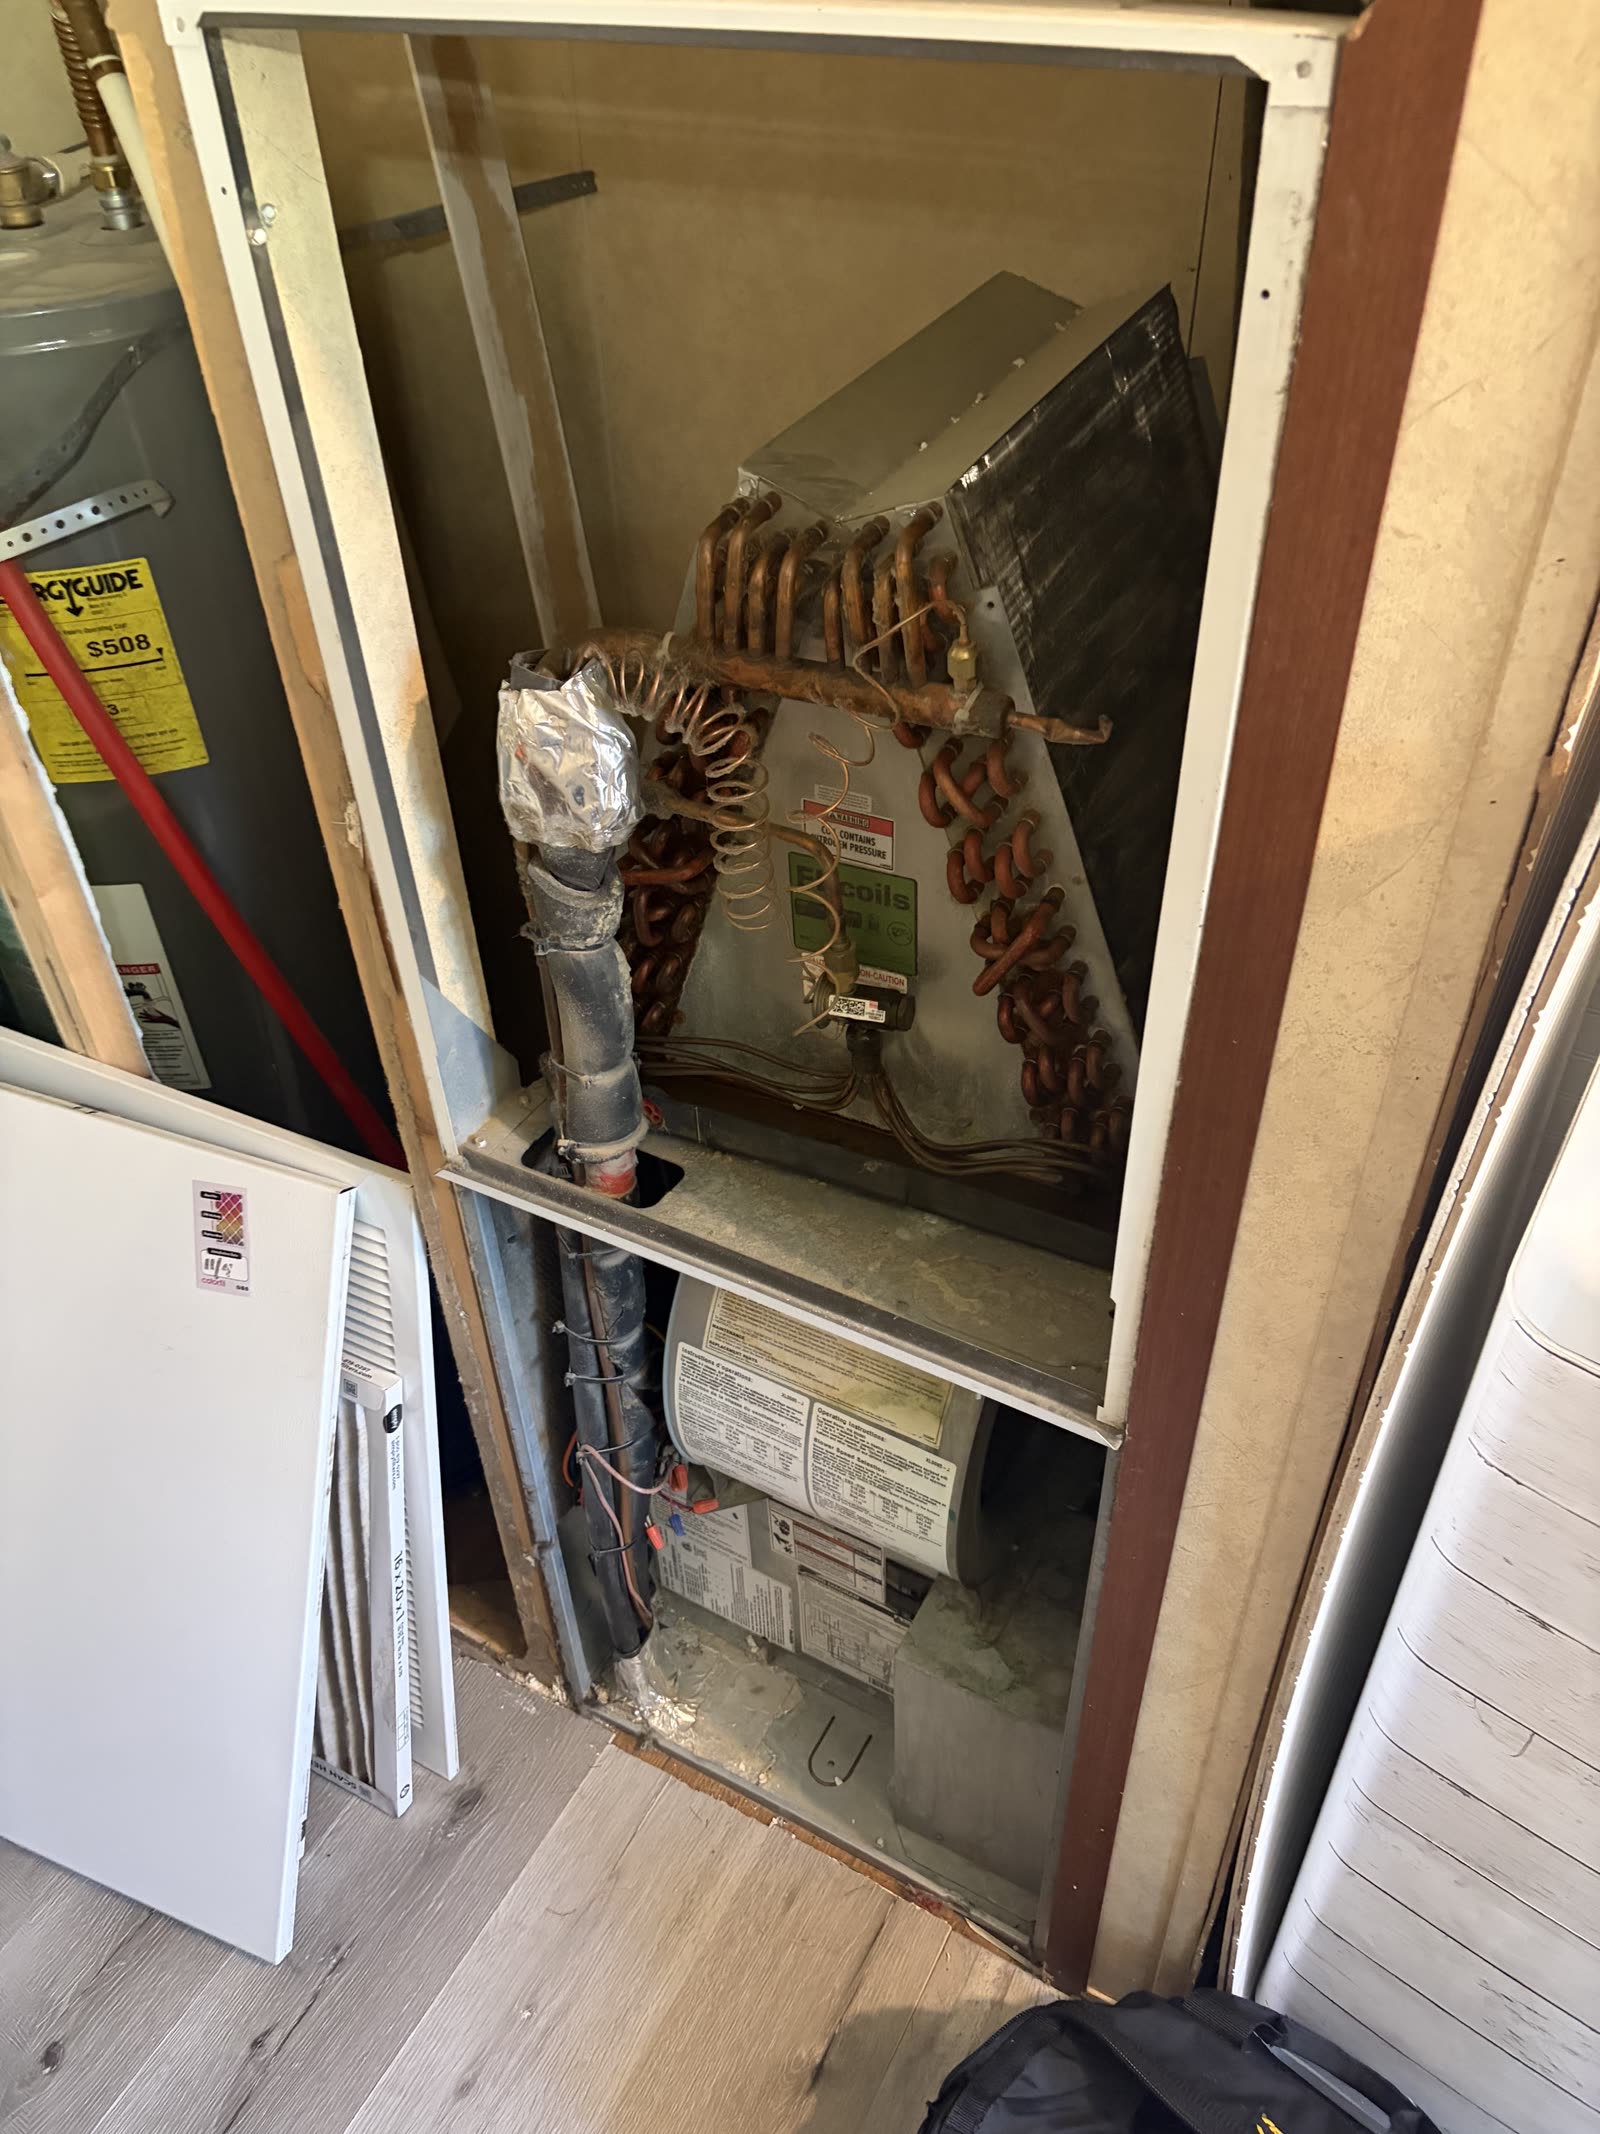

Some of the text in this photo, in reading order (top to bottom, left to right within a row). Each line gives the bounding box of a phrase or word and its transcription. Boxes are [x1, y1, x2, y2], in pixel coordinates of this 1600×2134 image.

[32, 569, 143, 603] RGYGUIDE
[86, 634, 150, 658] $508
[839, 830, 876, 847] CONTAINS
[849, 843, 887, 860] PRESSURE
[816, 1406, 848, 1425] Operating
